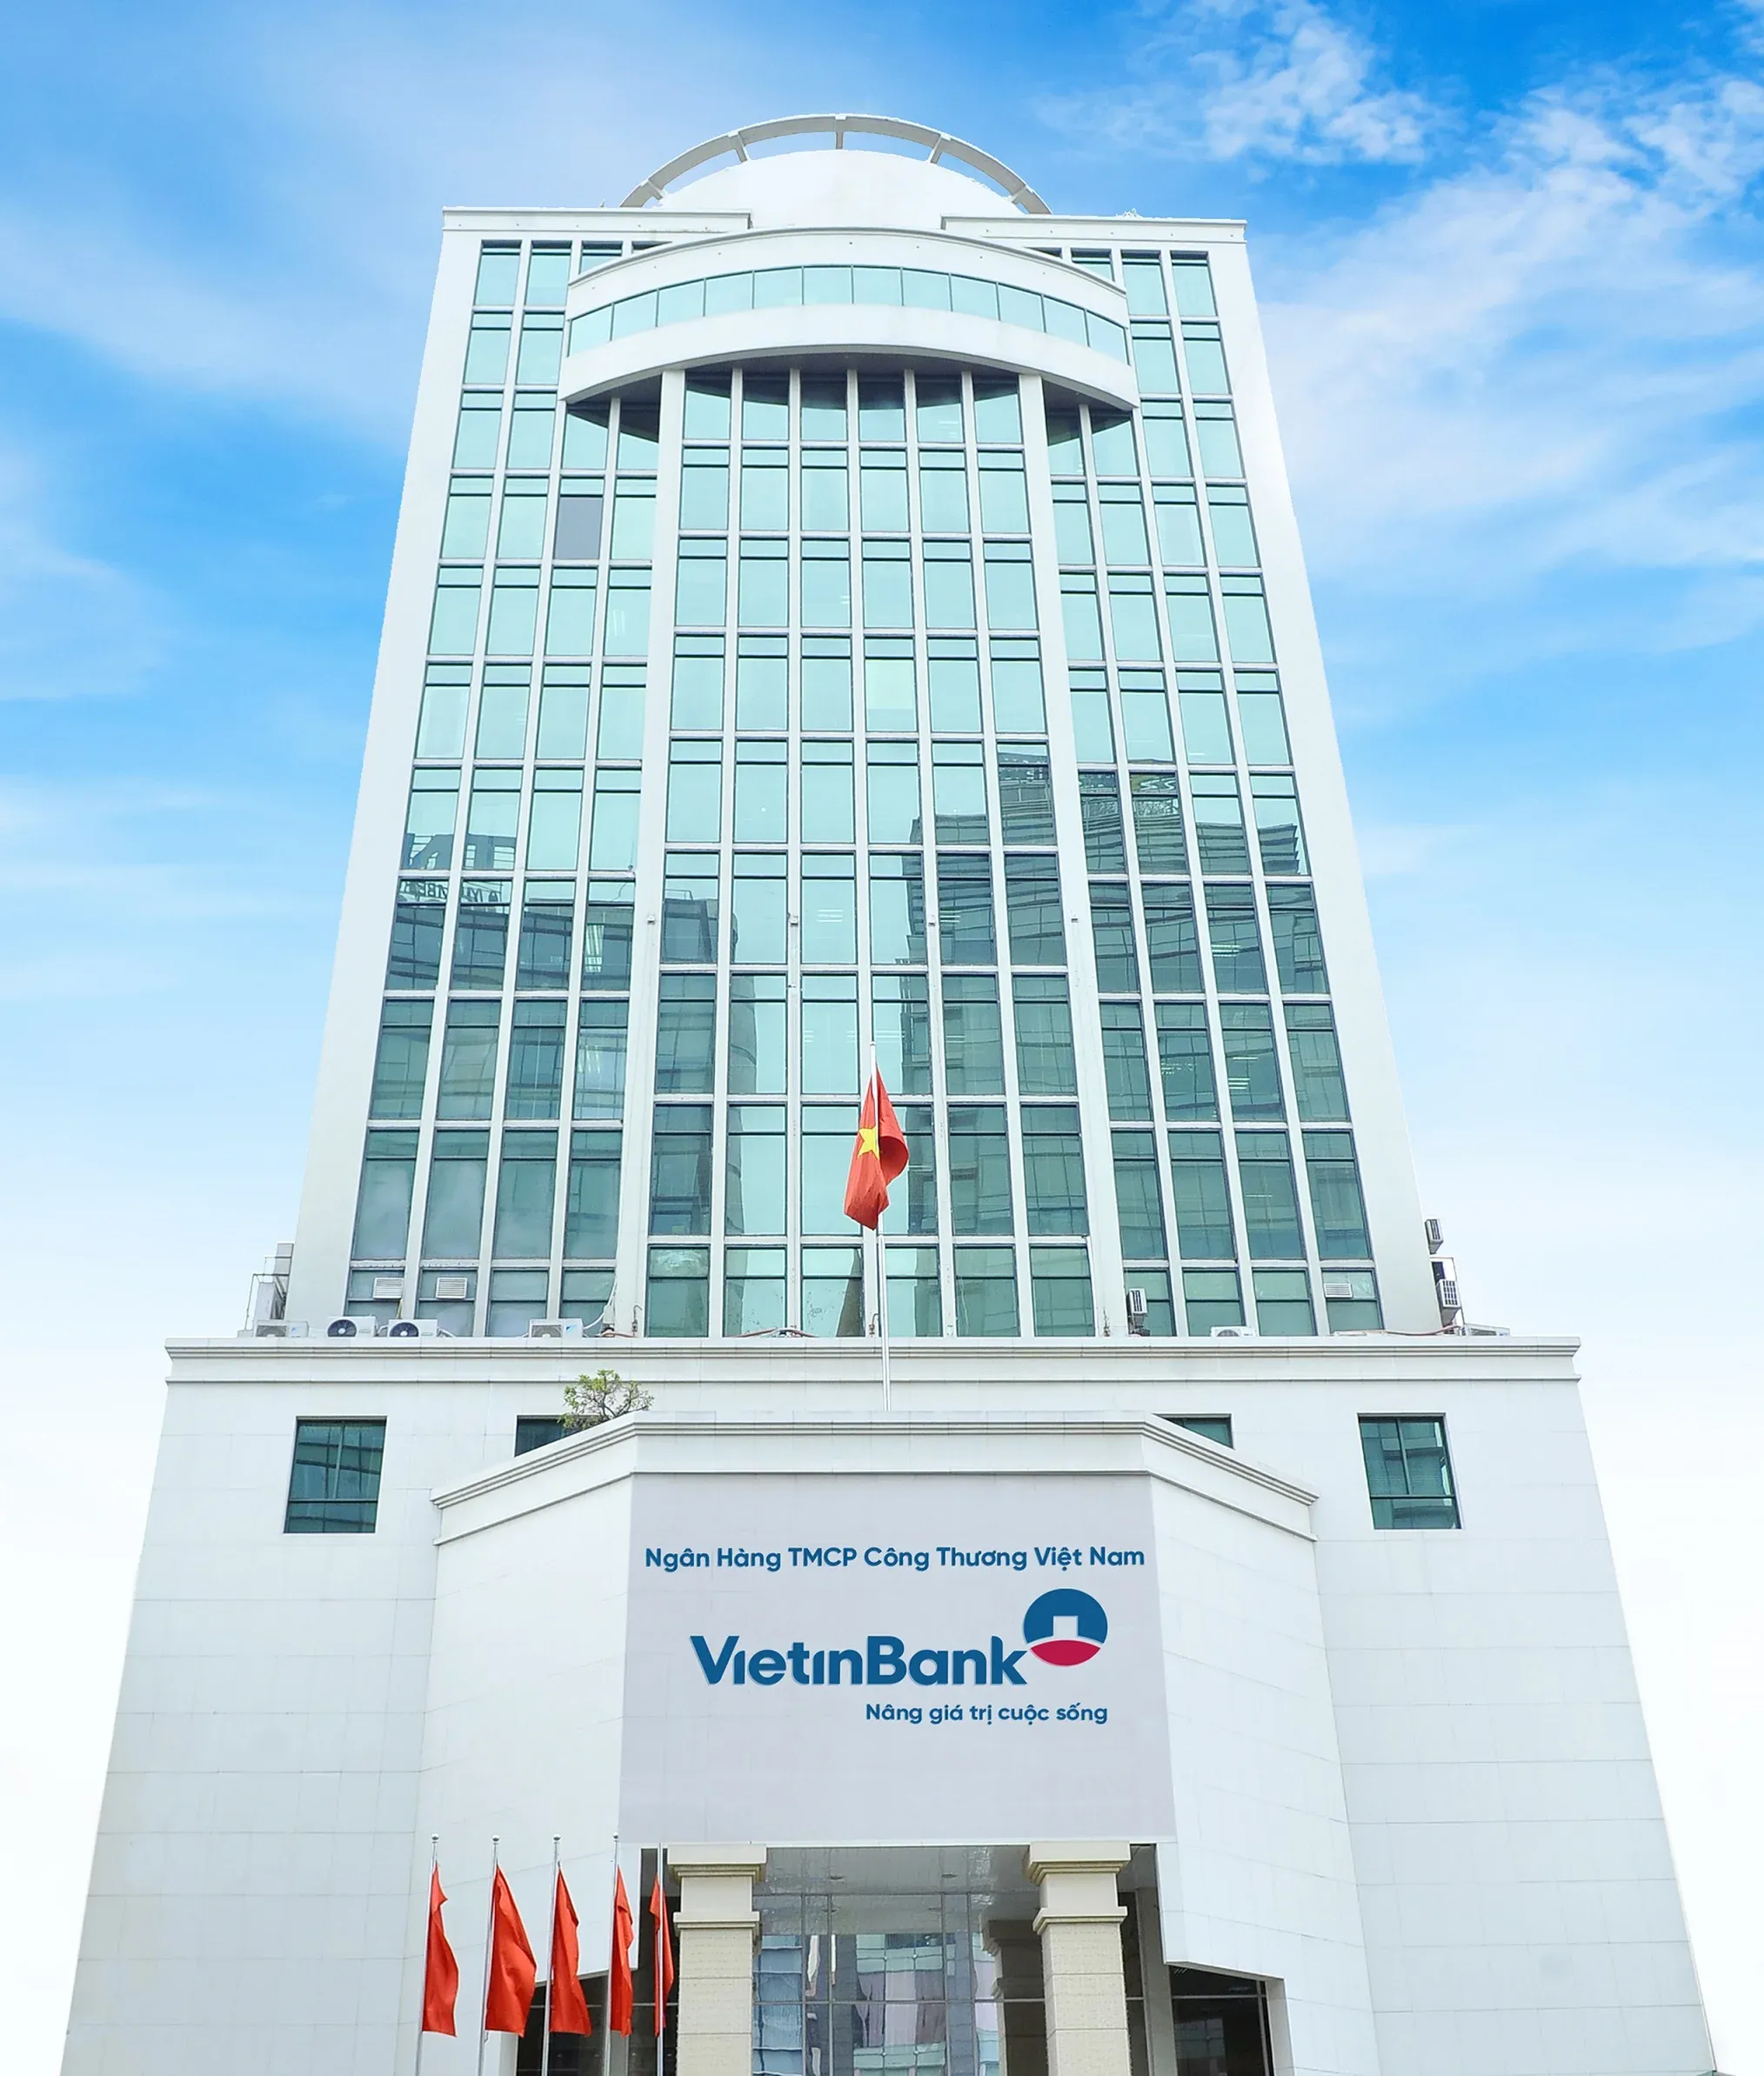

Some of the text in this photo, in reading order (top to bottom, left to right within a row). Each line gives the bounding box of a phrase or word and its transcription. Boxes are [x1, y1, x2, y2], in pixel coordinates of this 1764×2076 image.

[645, 1545, 1146, 1573] Ngân Hàng TMCP Công Thương Việt Nam
[690, 1635, 1027, 1686] VietinBank
[865, 1702, 1108, 1726] Nâng giá trị cuộc sống
